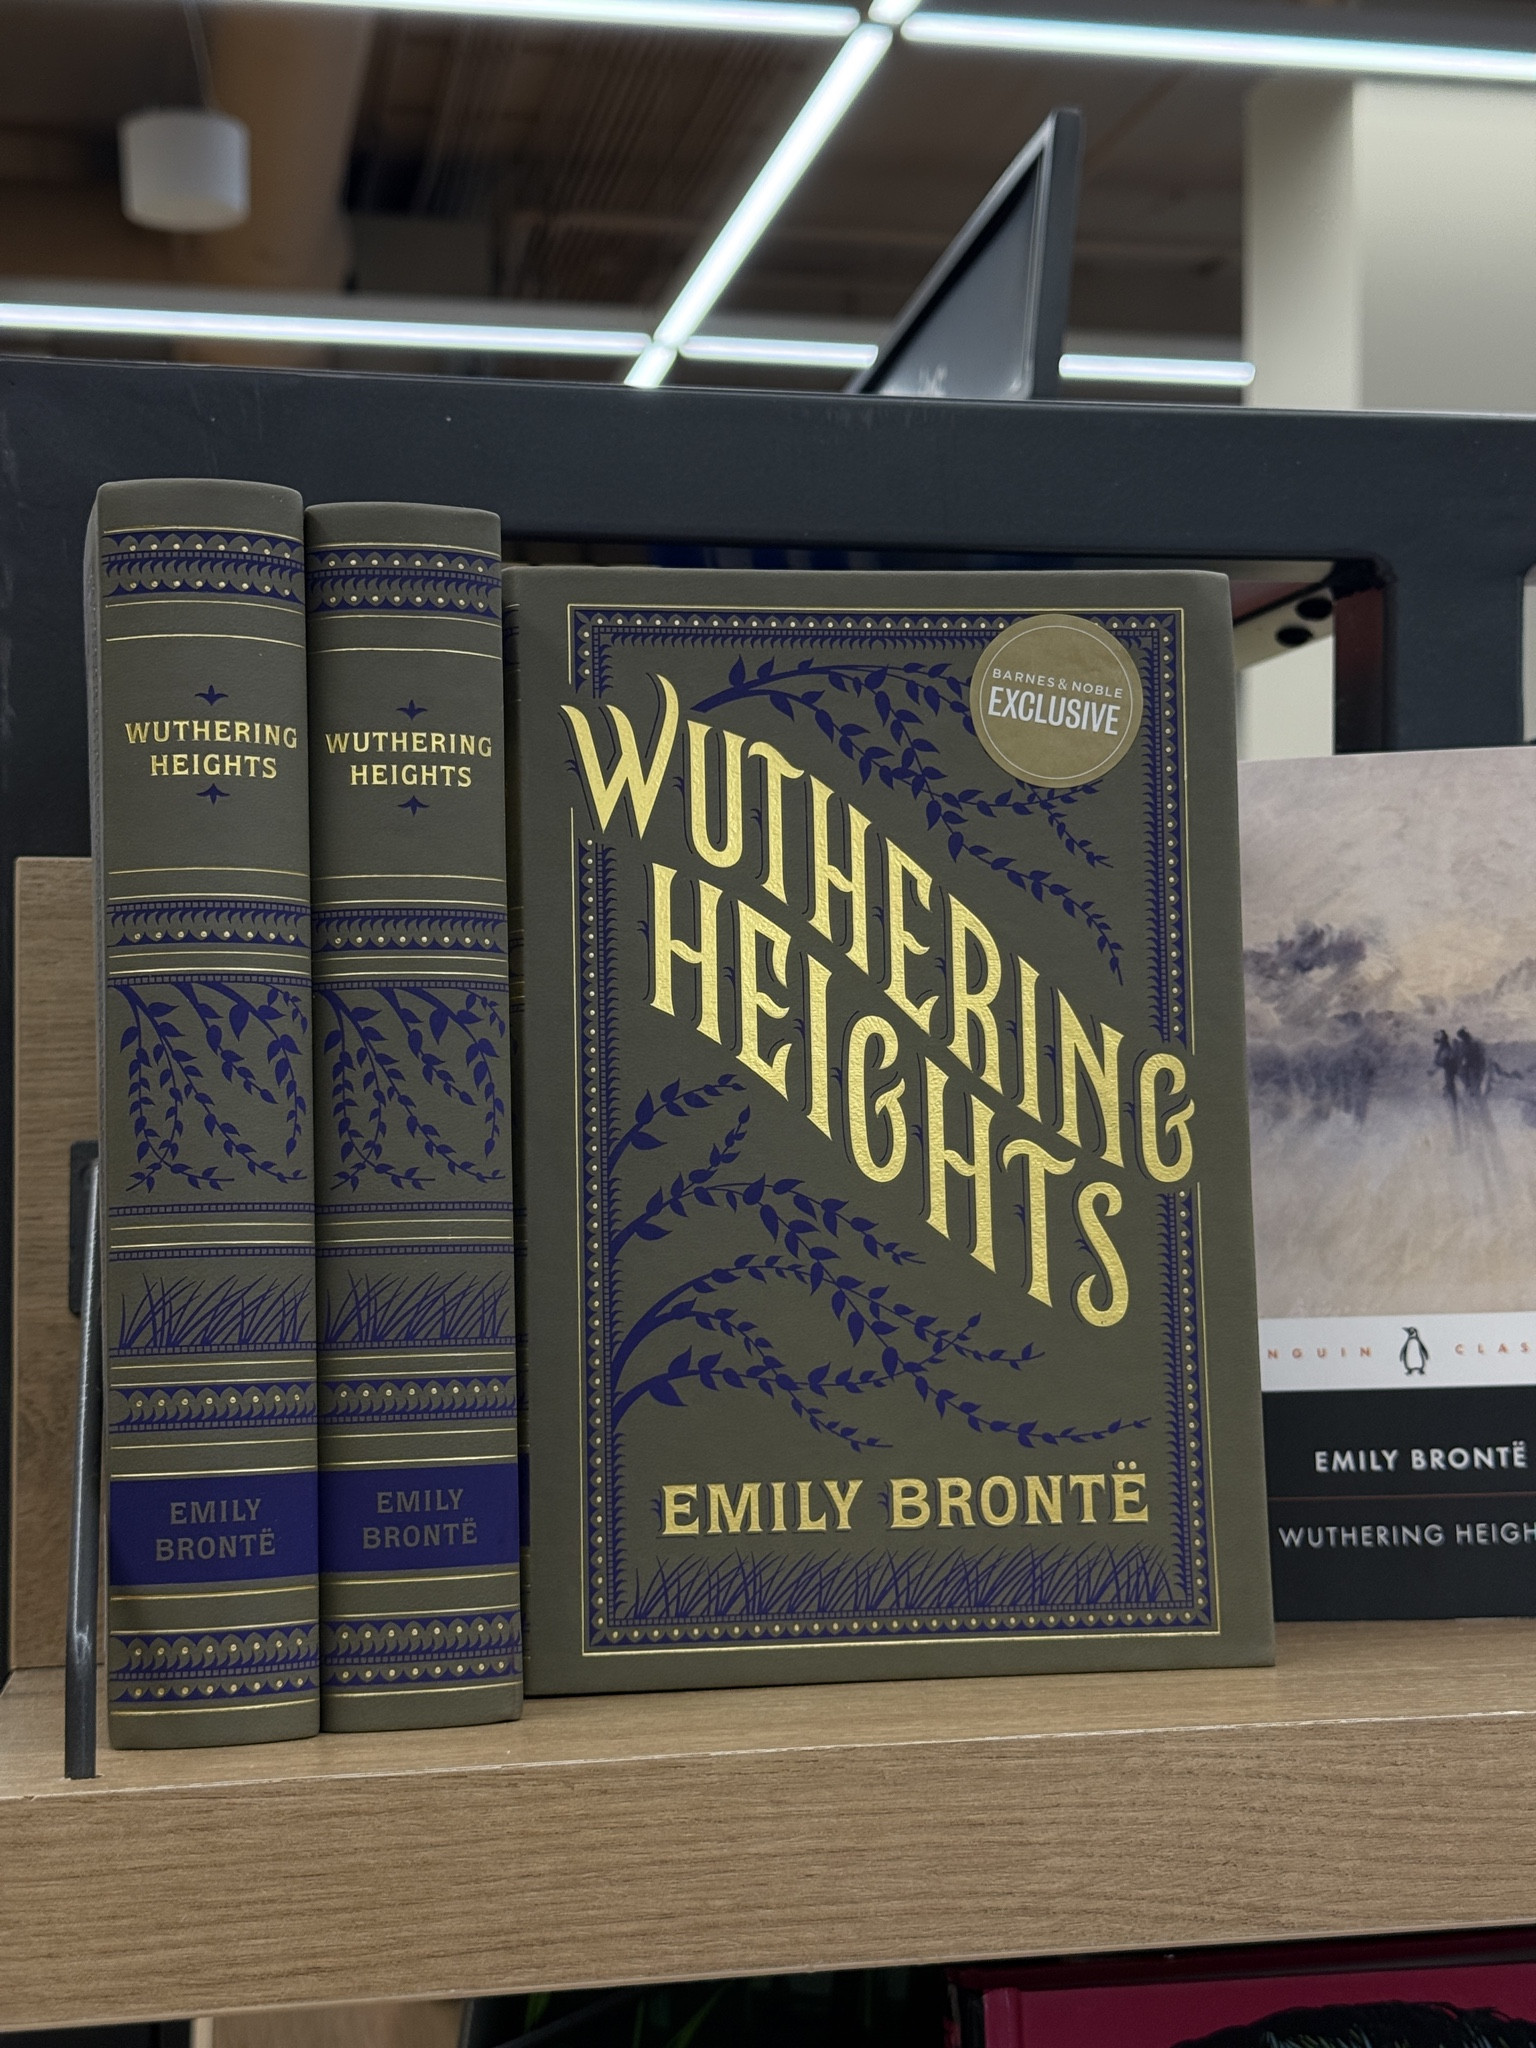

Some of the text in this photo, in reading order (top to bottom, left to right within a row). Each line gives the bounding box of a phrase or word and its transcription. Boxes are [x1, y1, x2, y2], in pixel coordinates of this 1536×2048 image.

[992, 668, 1123, 699] BARNES & NOBLE
[988, 686, 1120, 736] EXCLUSIVE
[125, 720, 297, 749] WUTHERING
[325, 732, 492, 758] WUTHERING
[150, 754, 277, 779] HEIGHTS
[350, 764, 472, 788] HEIGHTS
[561, 674, 1195, 1183] WUTHERING
[650, 862, 1129, 1326] HEIGHTS
[1314, 1440, 1528, 1473] EMILY BRONTË
[170, 1499, 262, 1525] EMILY
[376, 1489, 463, 1513] EMILY
[661, 1460, 1150, 1535] EMILY BRONTË
[155, 1528, 276, 1562] BRONTË
[362, 1518, 477, 1550] BRONTË
[1278, 1522, 1536, 1548] WUTHERING HEIGH
